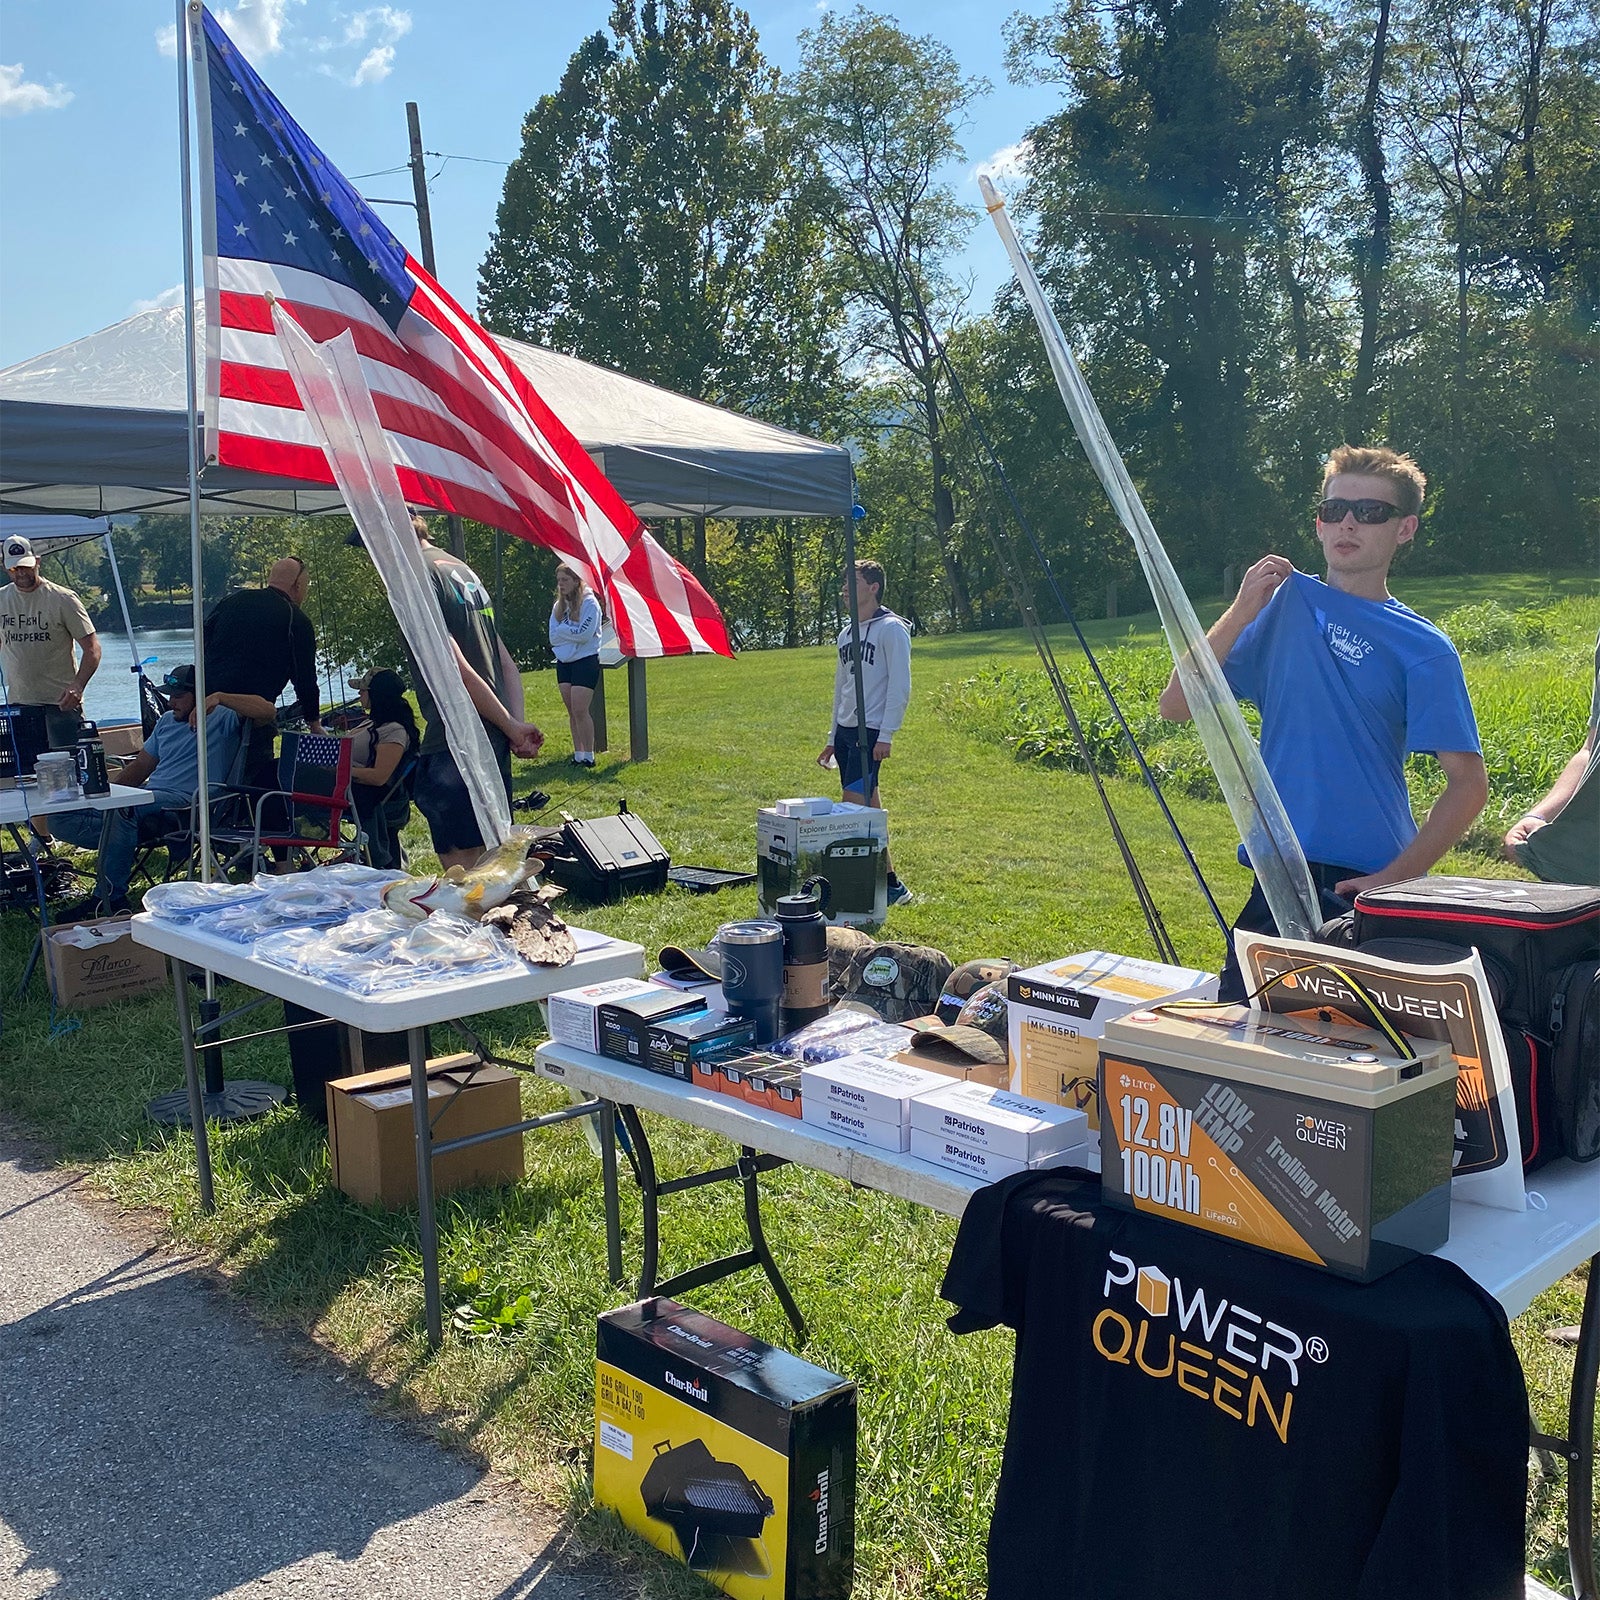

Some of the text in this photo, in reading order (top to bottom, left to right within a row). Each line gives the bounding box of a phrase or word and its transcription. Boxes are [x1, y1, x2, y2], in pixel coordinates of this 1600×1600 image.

[1, 613, 16, 629] THE
[4, 630, 51, 645] WHISPERER
[1327, 623, 1374, 654] FISH LIFE
[799, 825, 827, 834] Explorer
[81, 955, 131, 981] Marco
[1032, 990, 1080, 1009] MINN KOTA
[649, 1035, 674, 1052] APEX
[696, 1040, 734, 1055] ARDENT
[869, 1062, 925, 1082] Patriots
[837, 1085, 865, 1103] Patriots
[1132, 1079, 1156, 1091] LTCP
[1204, 1083, 1255, 1133] LOW-
[837, 1111, 865, 1129] Patriots
[952, 1117, 985, 1136] Patriots
[1120, 1094, 1193, 1158] 12.8V
[1192, 1098, 1244, 1153] TEMP
[1296, 1113, 1346, 1137] POWER
[1296, 1128, 1346, 1151] QUEEN
[953, 1146, 986, 1165] Patriots
[1120, 1147, 1201, 1216] 100Ah
[1265, 1135, 1362, 1240] Trolling Motor
[1206, 1210, 1237, 1226] LiFePO4
[666, 1325, 714, 1349] Char-Broil
[665, 1370, 708, 1402] Char-Broil
[1092, 1308, 1294, 1444] QUEEN
[600, 1373, 643, 1405] GAS GRILL 190
[621, 1398, 632, 1414] GAZ
[634, 1404, 645, 1420] 190
[815, 1469, 829, 1555] Char-Broil
